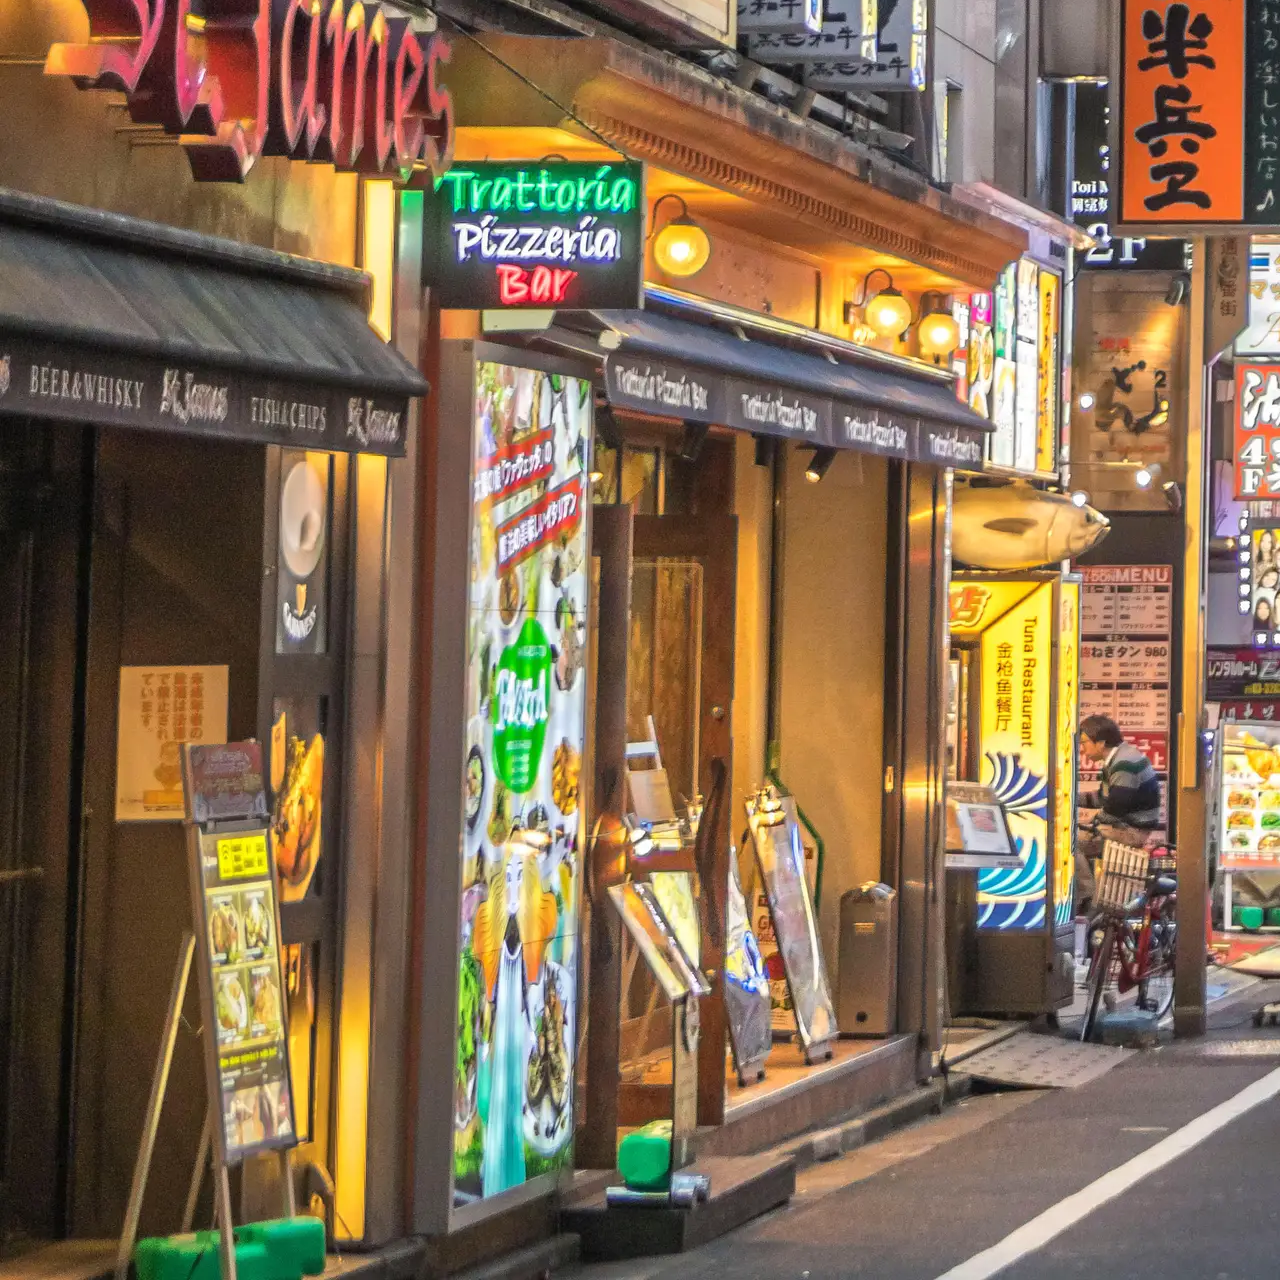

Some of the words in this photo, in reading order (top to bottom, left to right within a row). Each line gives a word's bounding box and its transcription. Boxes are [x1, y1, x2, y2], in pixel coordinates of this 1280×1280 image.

[450, 166, 636, 215] Trattoria
[453, 220, 621, 265] Pizzeria
[496, 263, 579, 305] Bar
[29, 363, 144, 409] BEER&WHISKY
[251, 396, 327, 431] FISH&CHIPS
[1022, 615, 1038, 654] Tuna
[995, 641, 1015, 733] 金枪鱼餐厅
[1021, 658, 1036, 748] Restaurant
